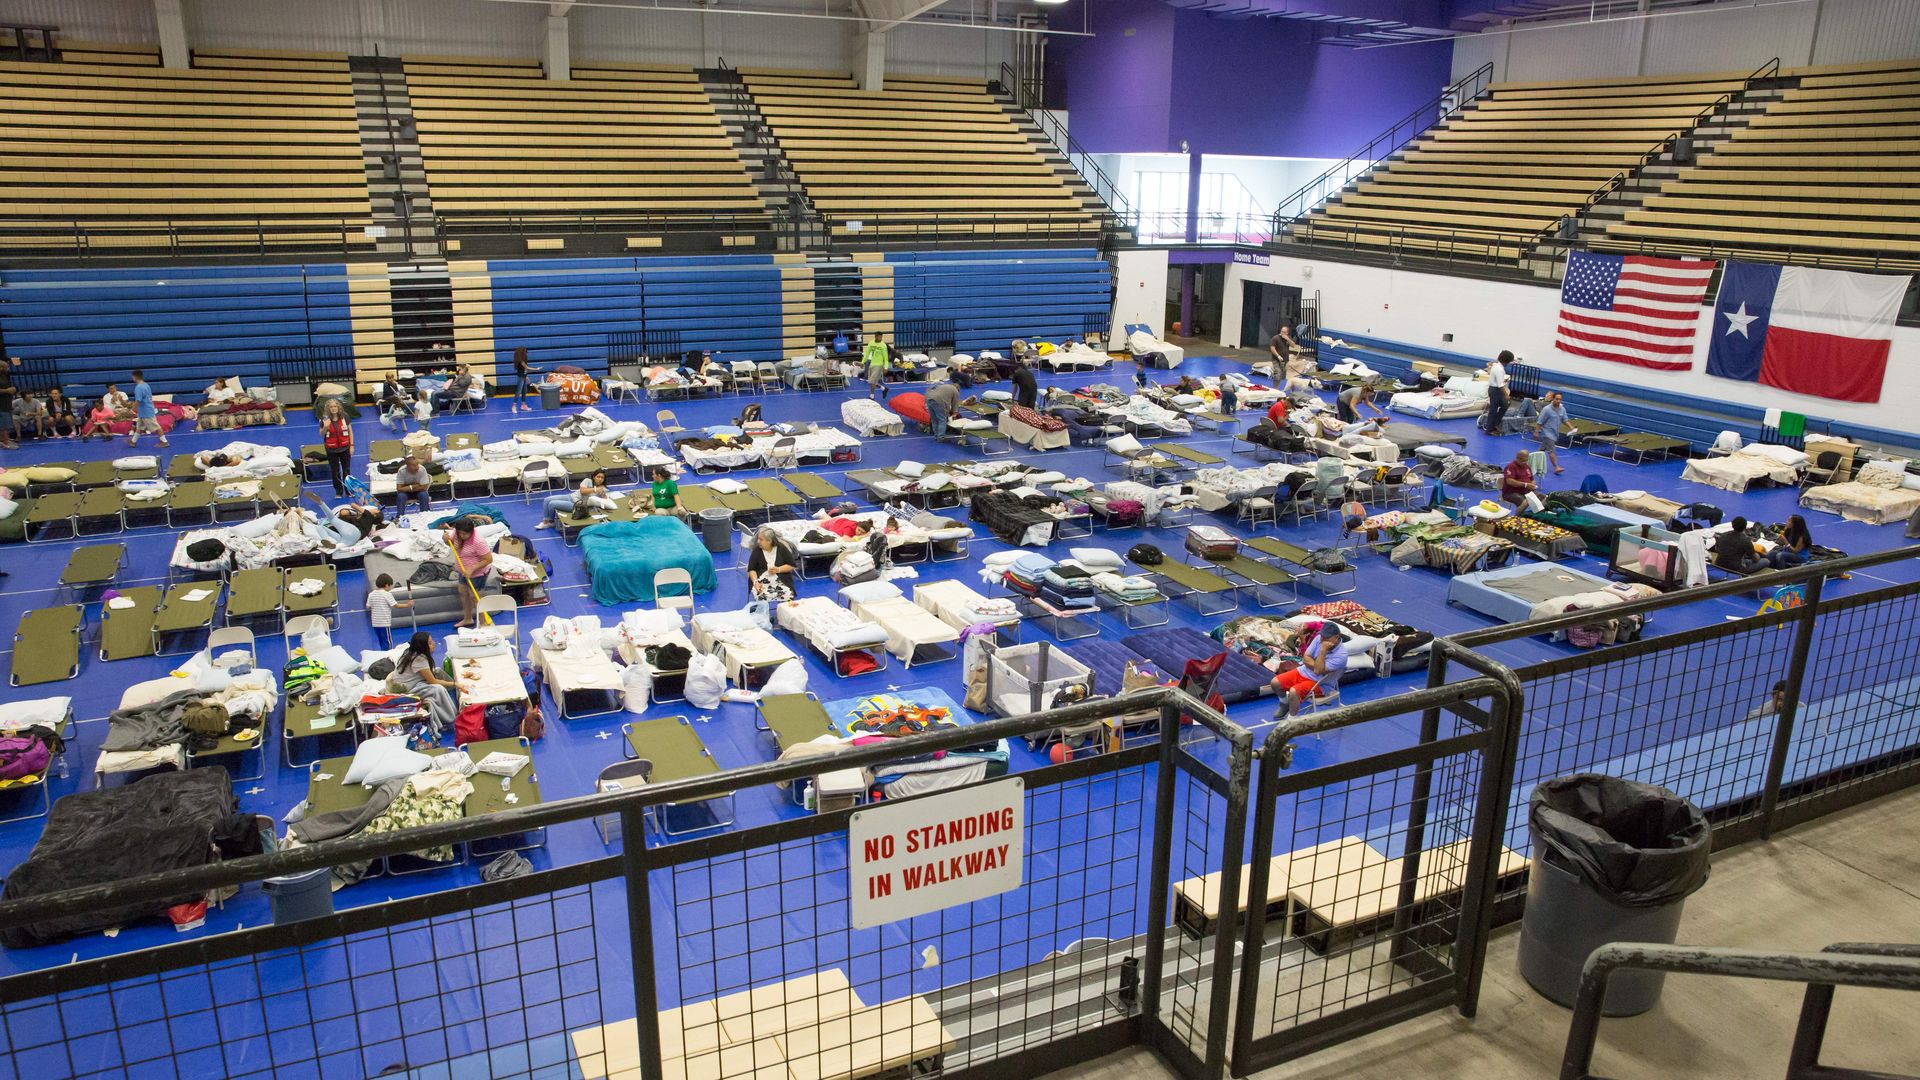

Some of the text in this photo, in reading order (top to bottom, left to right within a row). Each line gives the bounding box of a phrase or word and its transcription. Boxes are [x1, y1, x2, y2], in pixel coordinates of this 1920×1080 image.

[1234, 252, 1270, 265] Home Team
[571, 380, 588, 393] UT
[865, 807, 1014, 862] NO STANDING
[869, 844, 1009, 899] IN WALKWAY
